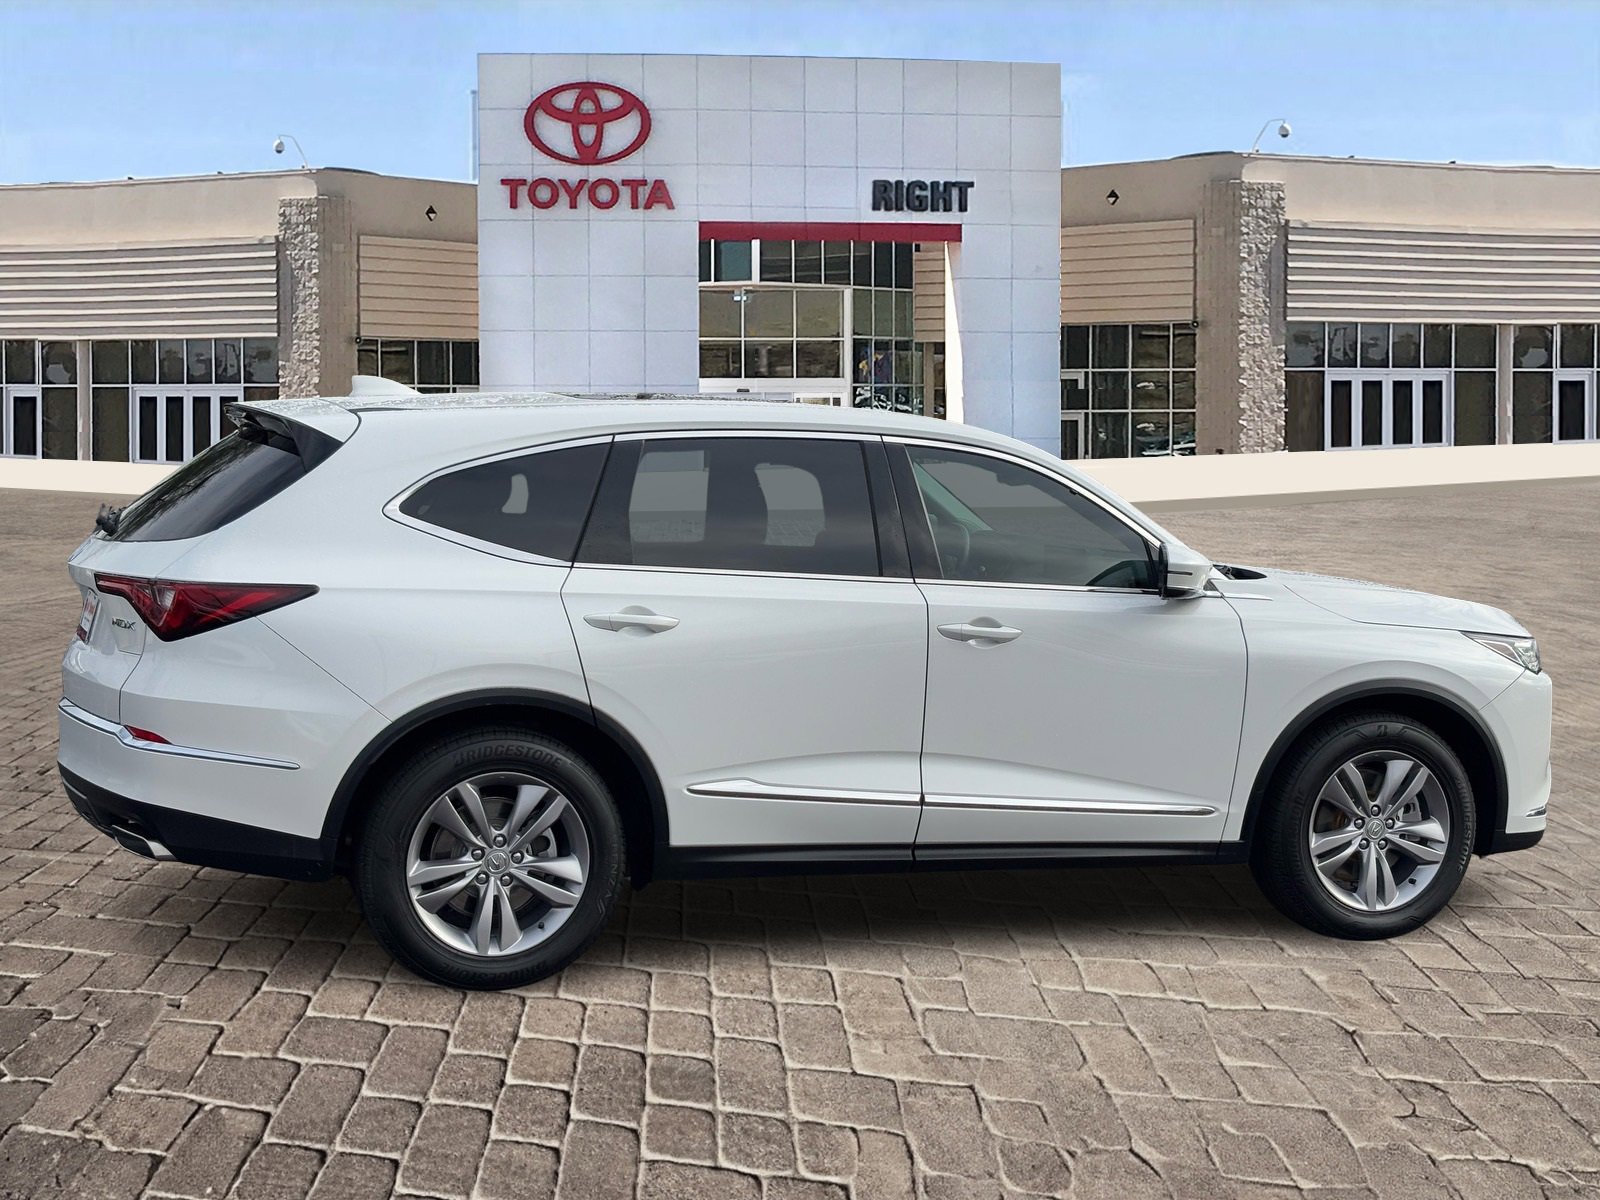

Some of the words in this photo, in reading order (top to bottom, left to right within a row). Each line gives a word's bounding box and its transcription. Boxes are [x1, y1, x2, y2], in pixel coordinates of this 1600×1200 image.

[500, 178, 675, 210] TOYOTA
[871, 179, 975, 213] RIGHT
[453, 743, 563, 769] BRIDGESTONE
